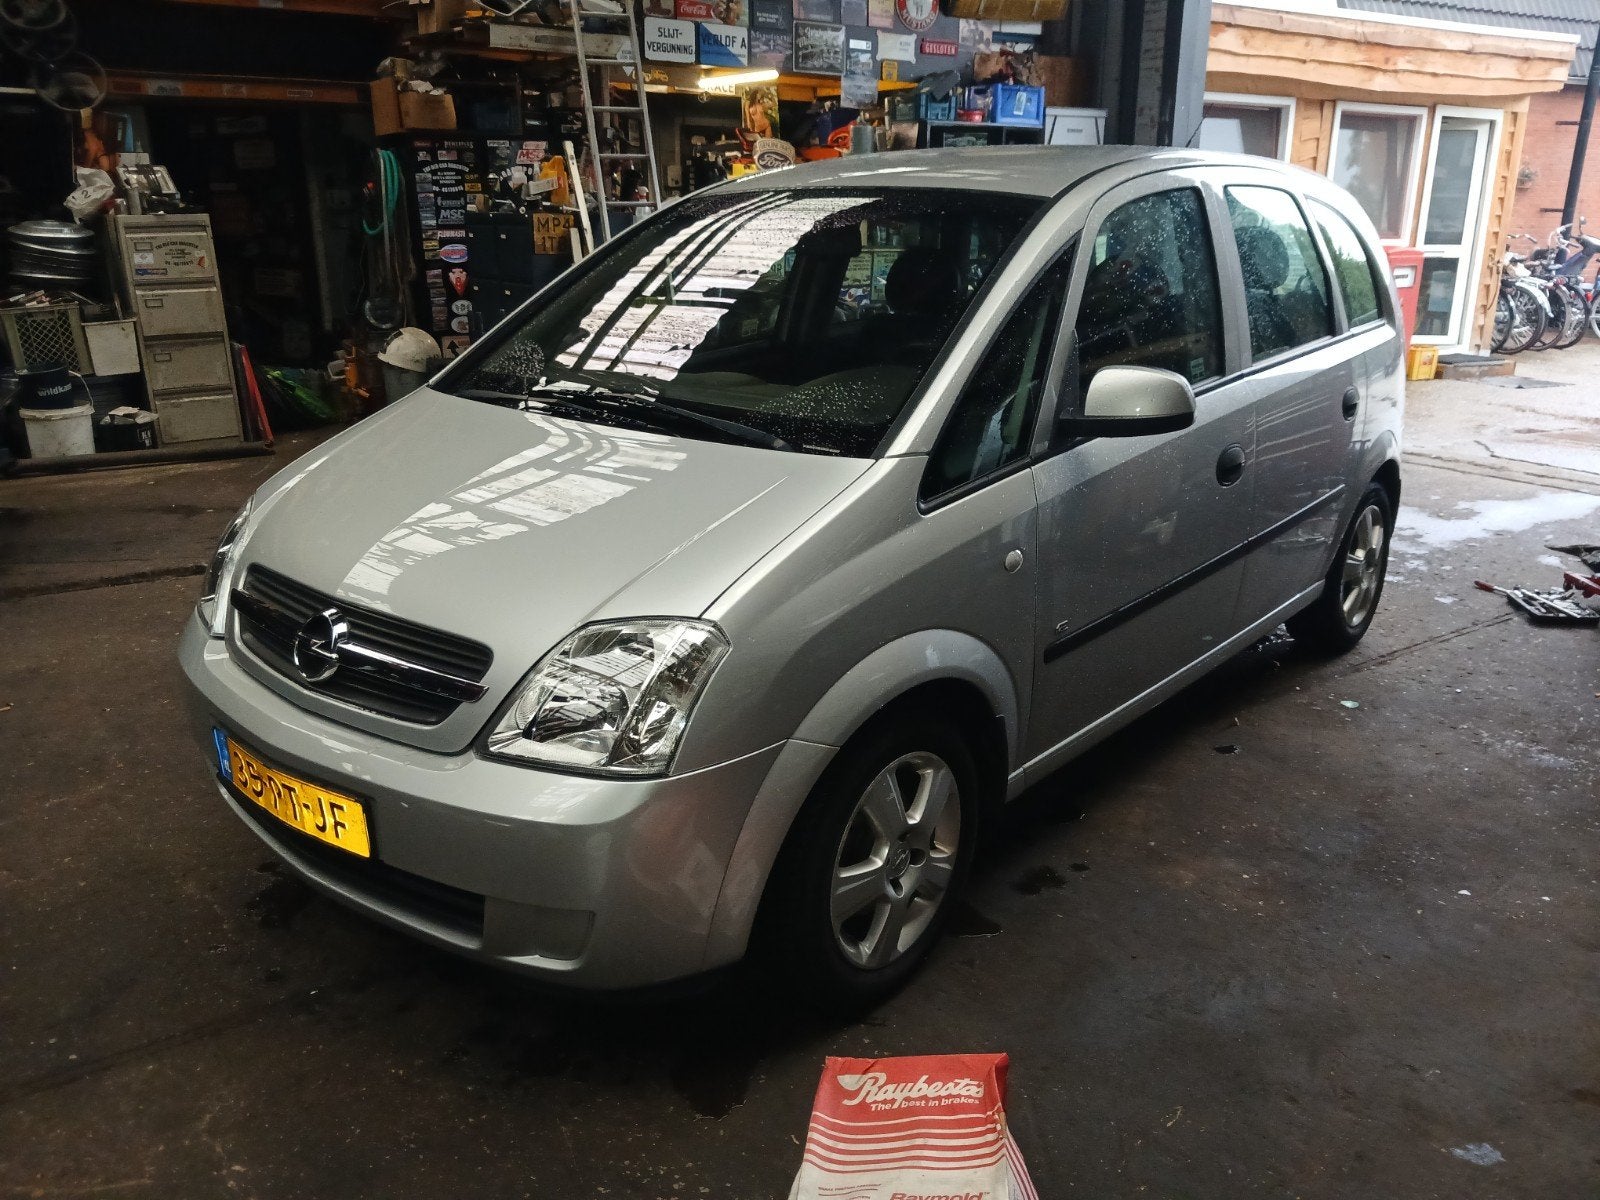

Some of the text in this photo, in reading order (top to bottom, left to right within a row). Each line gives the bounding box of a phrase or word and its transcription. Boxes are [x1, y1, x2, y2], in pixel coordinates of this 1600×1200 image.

[902, 9, 937, 30] MUSTANG
[657, 26, 683, 38] SLIJT-
[647, 40, 693, 55] VERGUNNING
[740, 35, 747, 49] A
[925, 42, 956, 55] GESLOTEN
[758, 153, 790, 169] Ford
[836, 1072, 985, 1109] Raybestos
[870, 1096, 980, 1112] The best in brakes
